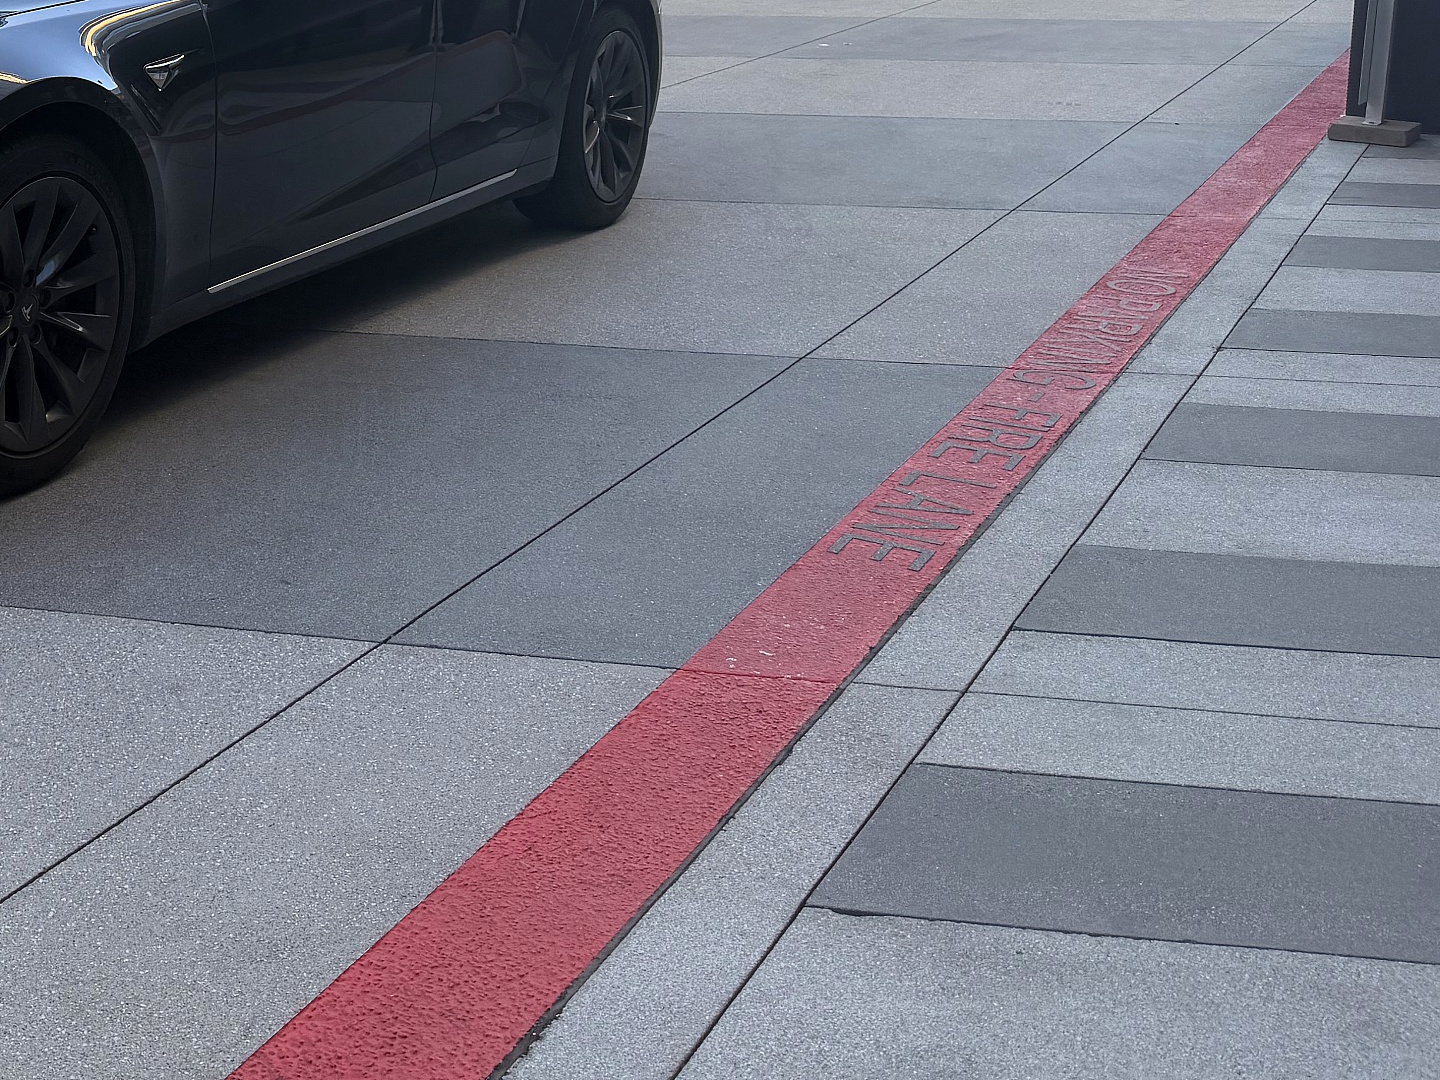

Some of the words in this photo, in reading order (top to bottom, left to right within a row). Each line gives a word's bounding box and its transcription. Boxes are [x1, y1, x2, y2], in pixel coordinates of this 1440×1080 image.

[1106, 270, 1189, 296] NO
[1006, 293, 1163, 390] PARKING
[928, 401, 1063, 470] FIRE
[827, 472, 997, 572] LANE
